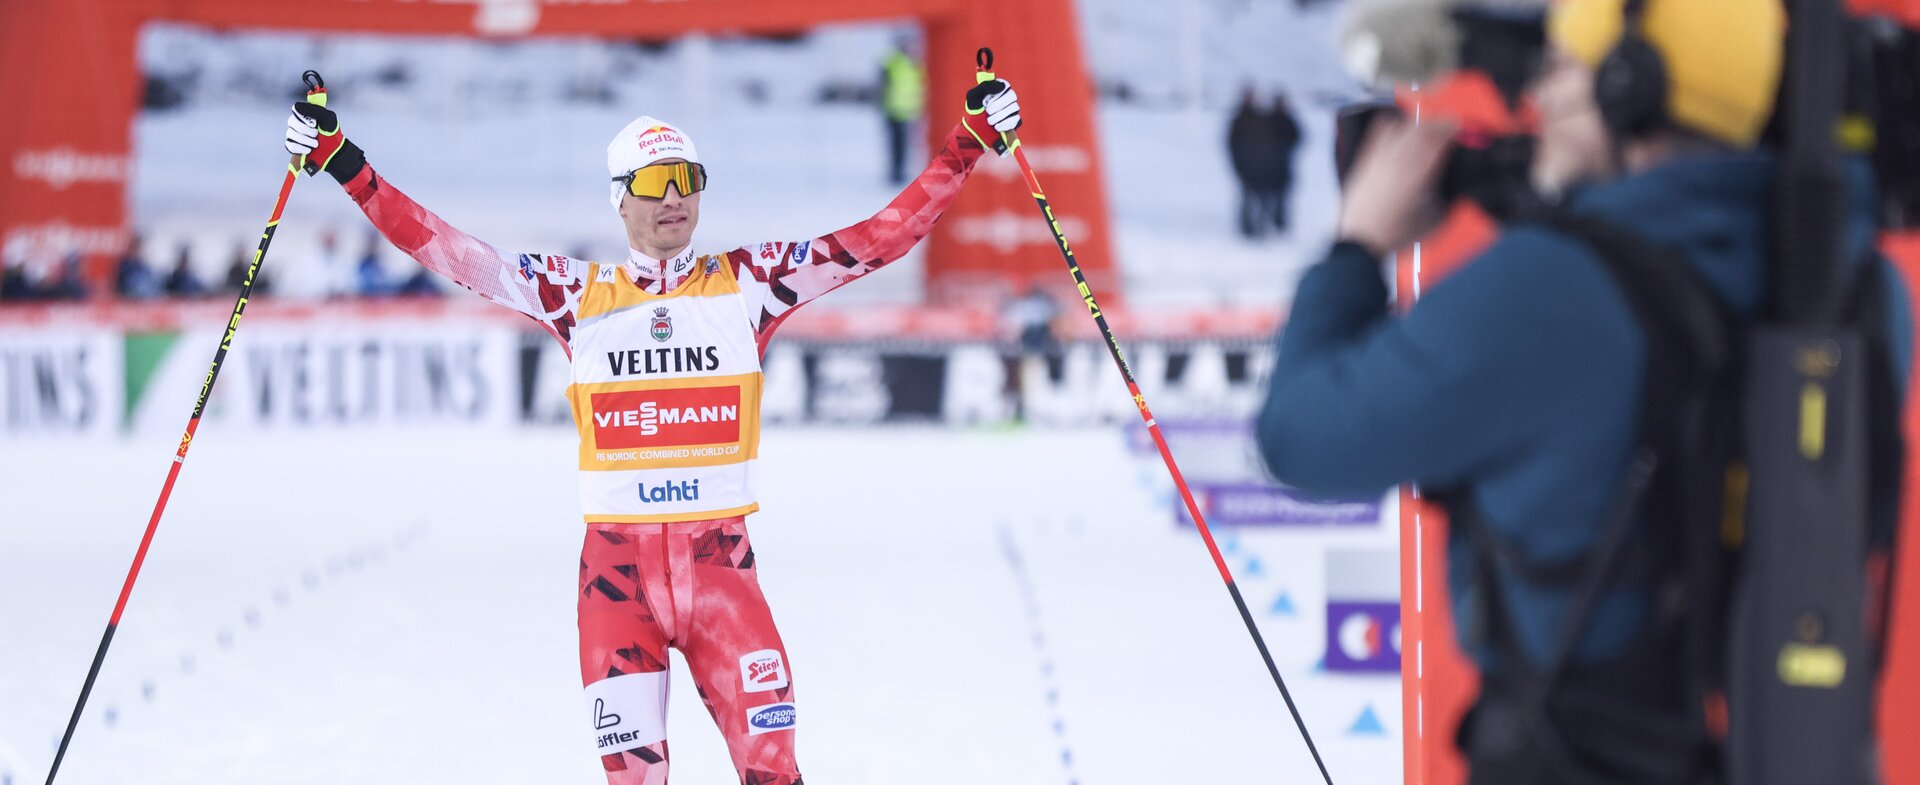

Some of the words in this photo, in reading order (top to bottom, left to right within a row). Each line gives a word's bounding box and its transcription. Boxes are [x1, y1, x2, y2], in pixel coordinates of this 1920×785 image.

[639, 134, 662, 149] Red
[663, 134, 684, 145] Bull
[1070, 266, 1101, 319] LEKI
[221, 297, 248, 351] LEKI
[607, 345, 720, 377] VELTINS
[594, 401, 737, 436] VIESSMANN
[596, 452, 606, 461] FIS
[607, 451, 637, 461] NORDIC
[640, 448, 689, 460] COMBINED
[691, 446, 724, 457] WORLD
[725, 445, 739, 455] CUP
[638, 478, 699, 503] Lahti
[748, 658, 779, 681] Stiegl
[755, 708, 796, 723] persona
[766, 714, 791, 726] shop
[597, 729, 640, 749] öffler
